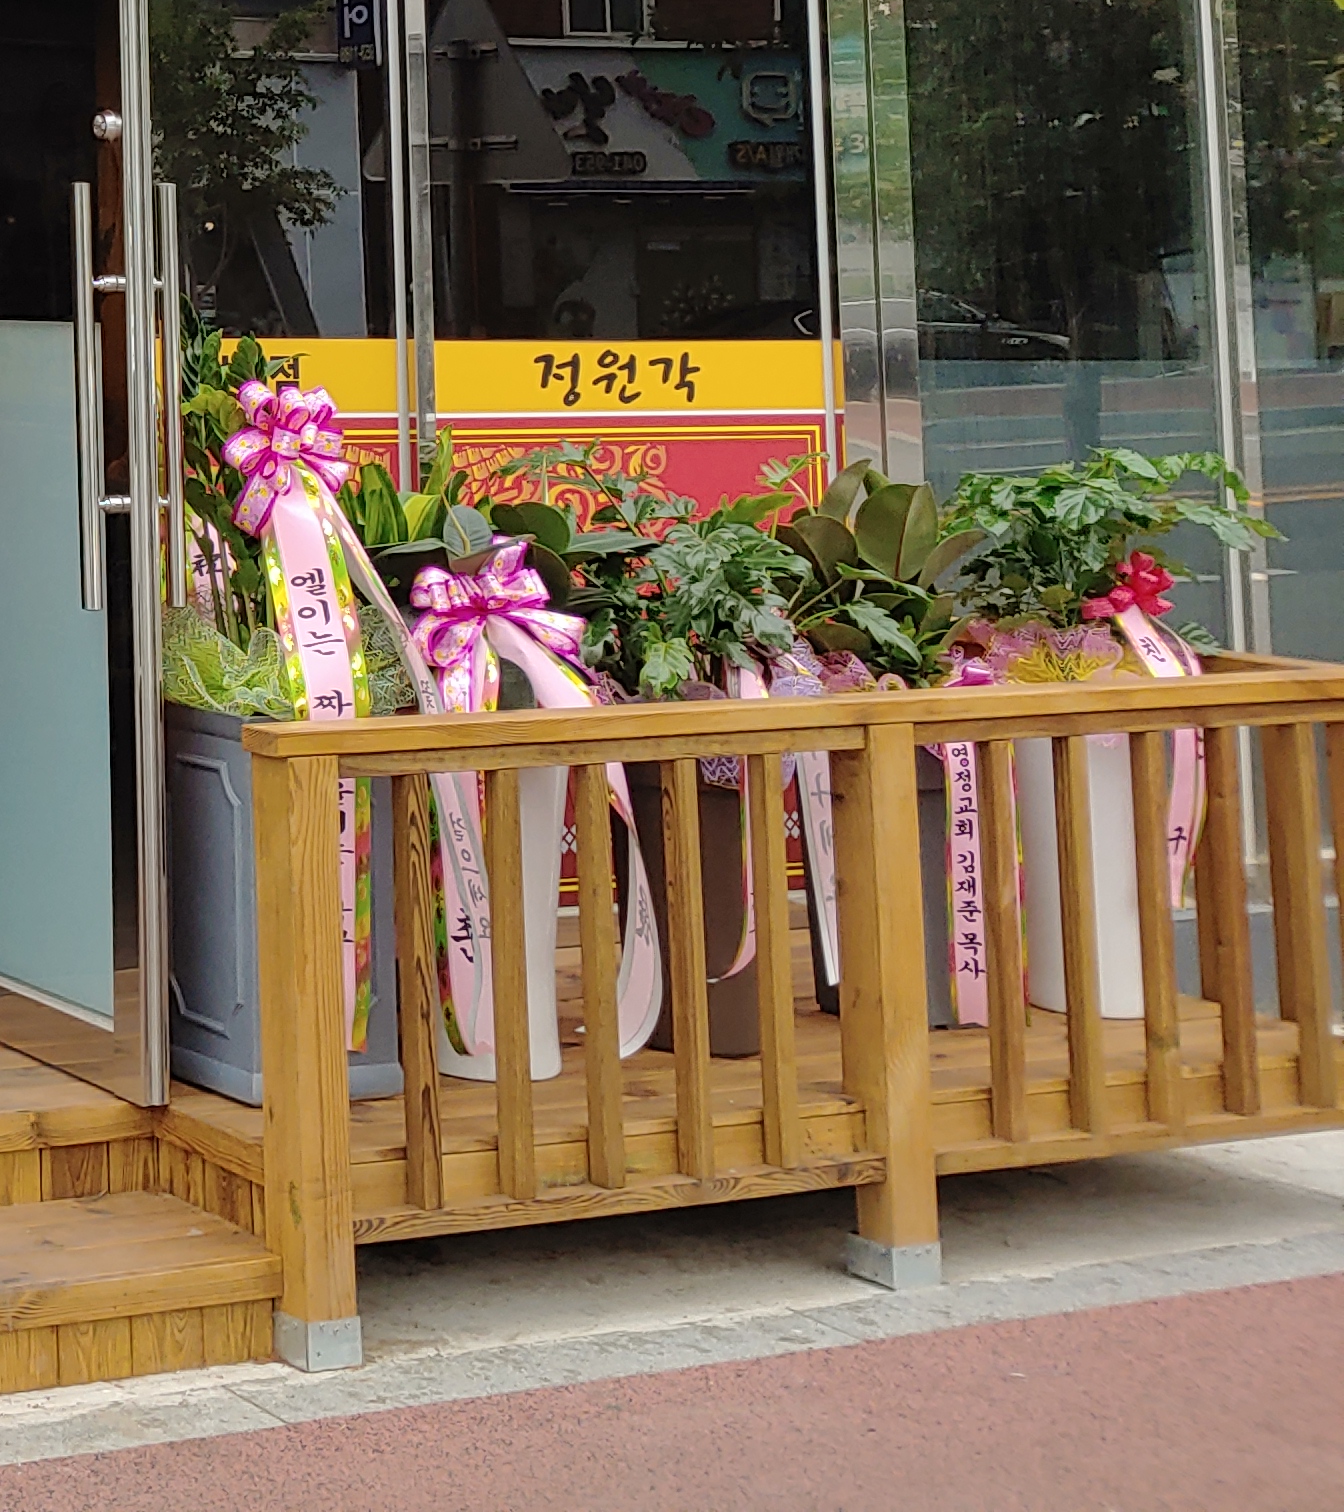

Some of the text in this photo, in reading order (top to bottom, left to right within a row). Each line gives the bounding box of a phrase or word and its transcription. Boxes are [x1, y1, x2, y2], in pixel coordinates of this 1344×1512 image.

[534, 349, 701, 406] 정원각
[954, 851, 982, 923] 김재준
[957, 931, 986, 980] 목사
